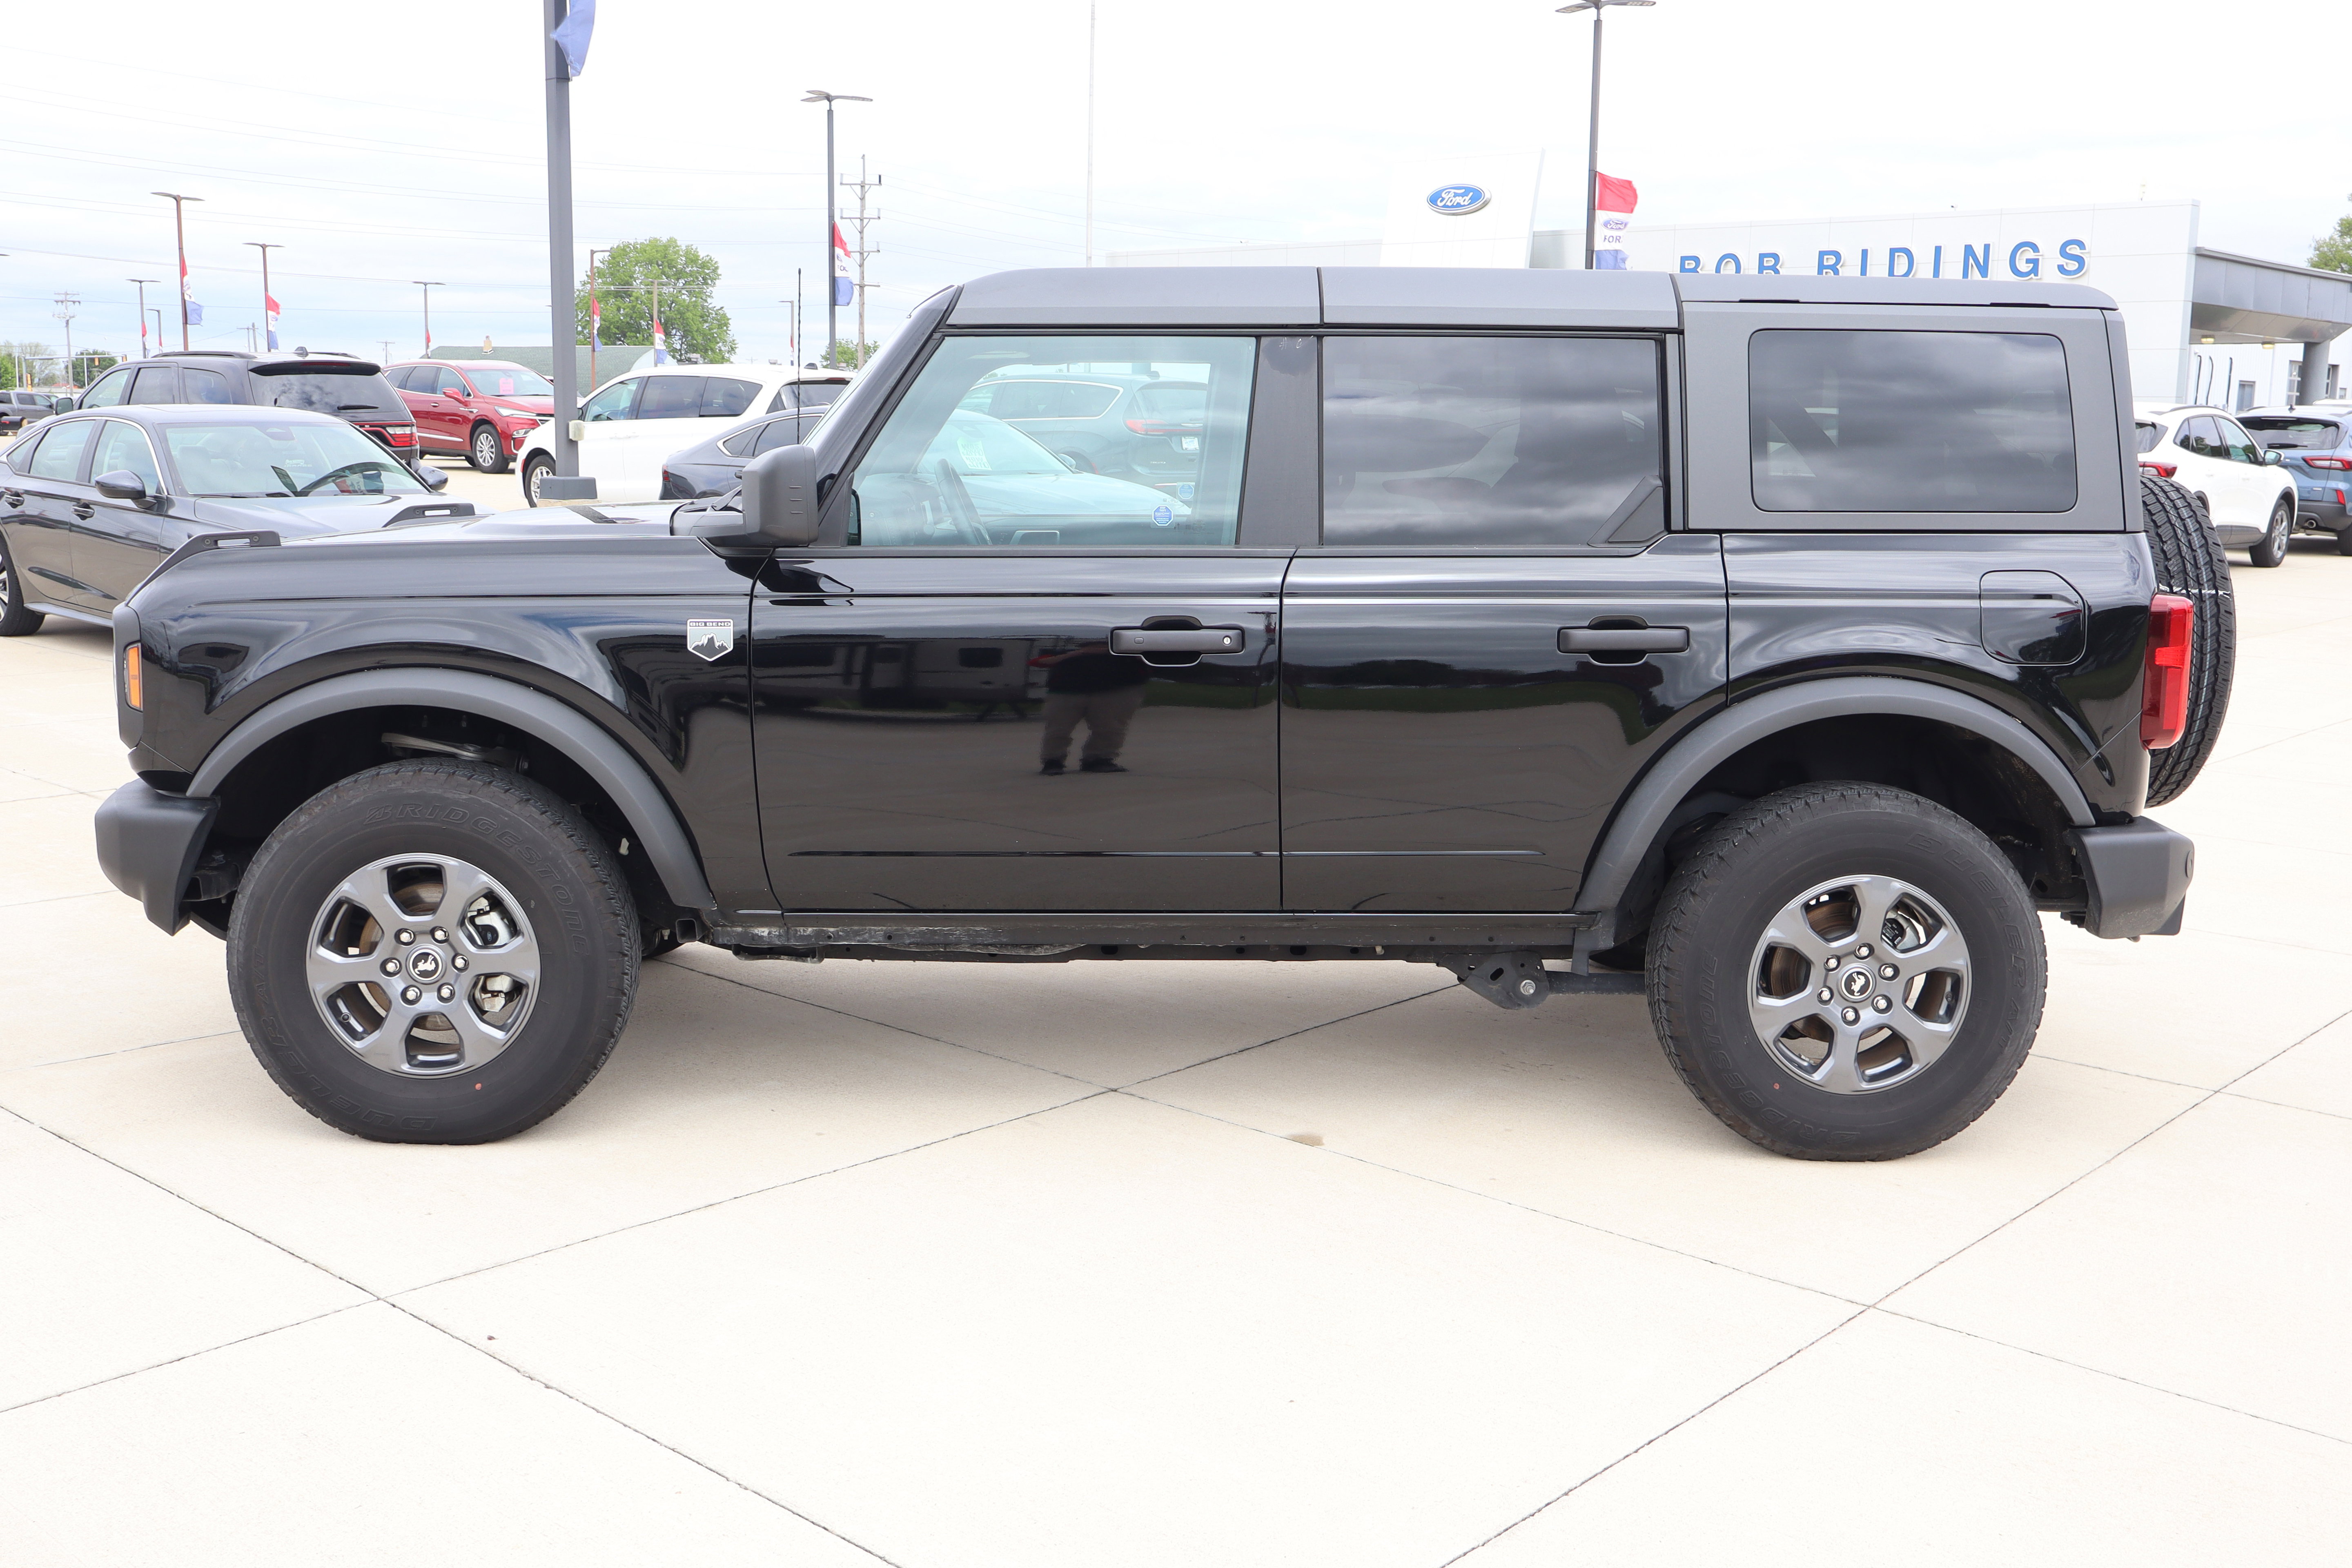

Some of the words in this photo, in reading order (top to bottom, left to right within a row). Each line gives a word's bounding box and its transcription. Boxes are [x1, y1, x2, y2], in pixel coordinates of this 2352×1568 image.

[1437, 189, 1473, 207] Ford
[1604, 235, 1623, 243] FOR
[1608, 220, 1625, 229] Ford
[1817, 239, 2088, 279] RIDINGS
[363, 802, 590, 957] BRIDGESTONE
[1699, 950, 1861, 1145] BRIDGESTONE
[262, 1016, 439, 1131] DUELER
